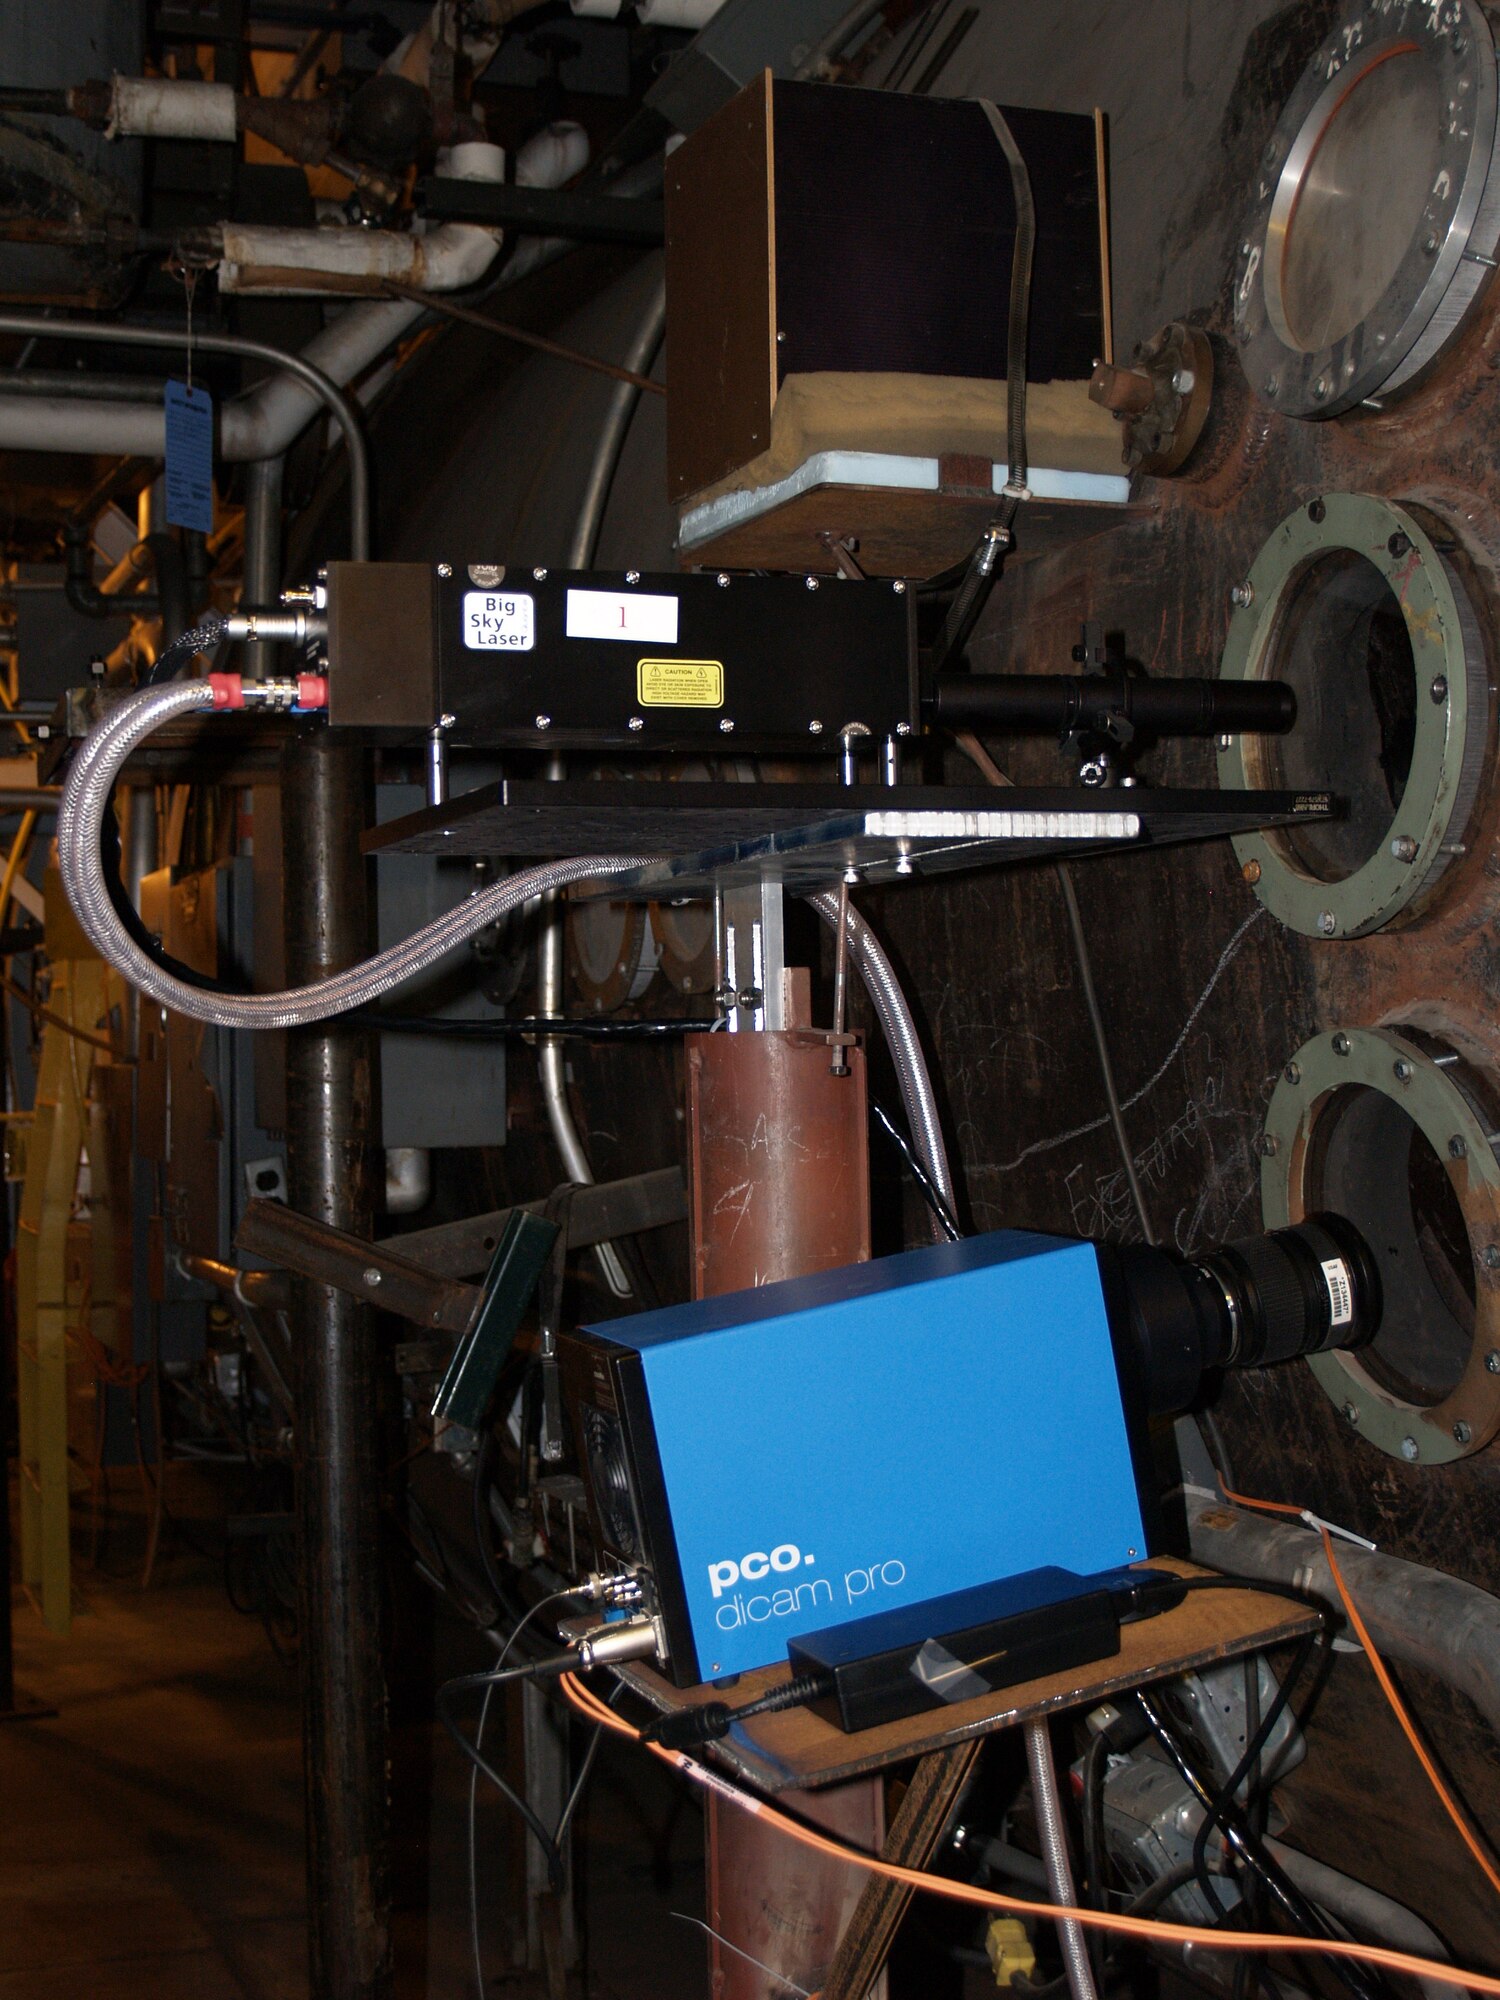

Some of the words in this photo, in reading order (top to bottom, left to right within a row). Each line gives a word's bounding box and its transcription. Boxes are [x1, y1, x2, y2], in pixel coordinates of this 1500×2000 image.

[486, 598, 515, 616] Big
[619, 606, 627, 628] 1
[471, 613, 504, 632] Sky
[478, 631, 527, 645] Laser
[708, 1543, 815, 1598] pco.
[715, 1579, 833, 1630] dicam
[844, 1560, 905, 1605] pro
